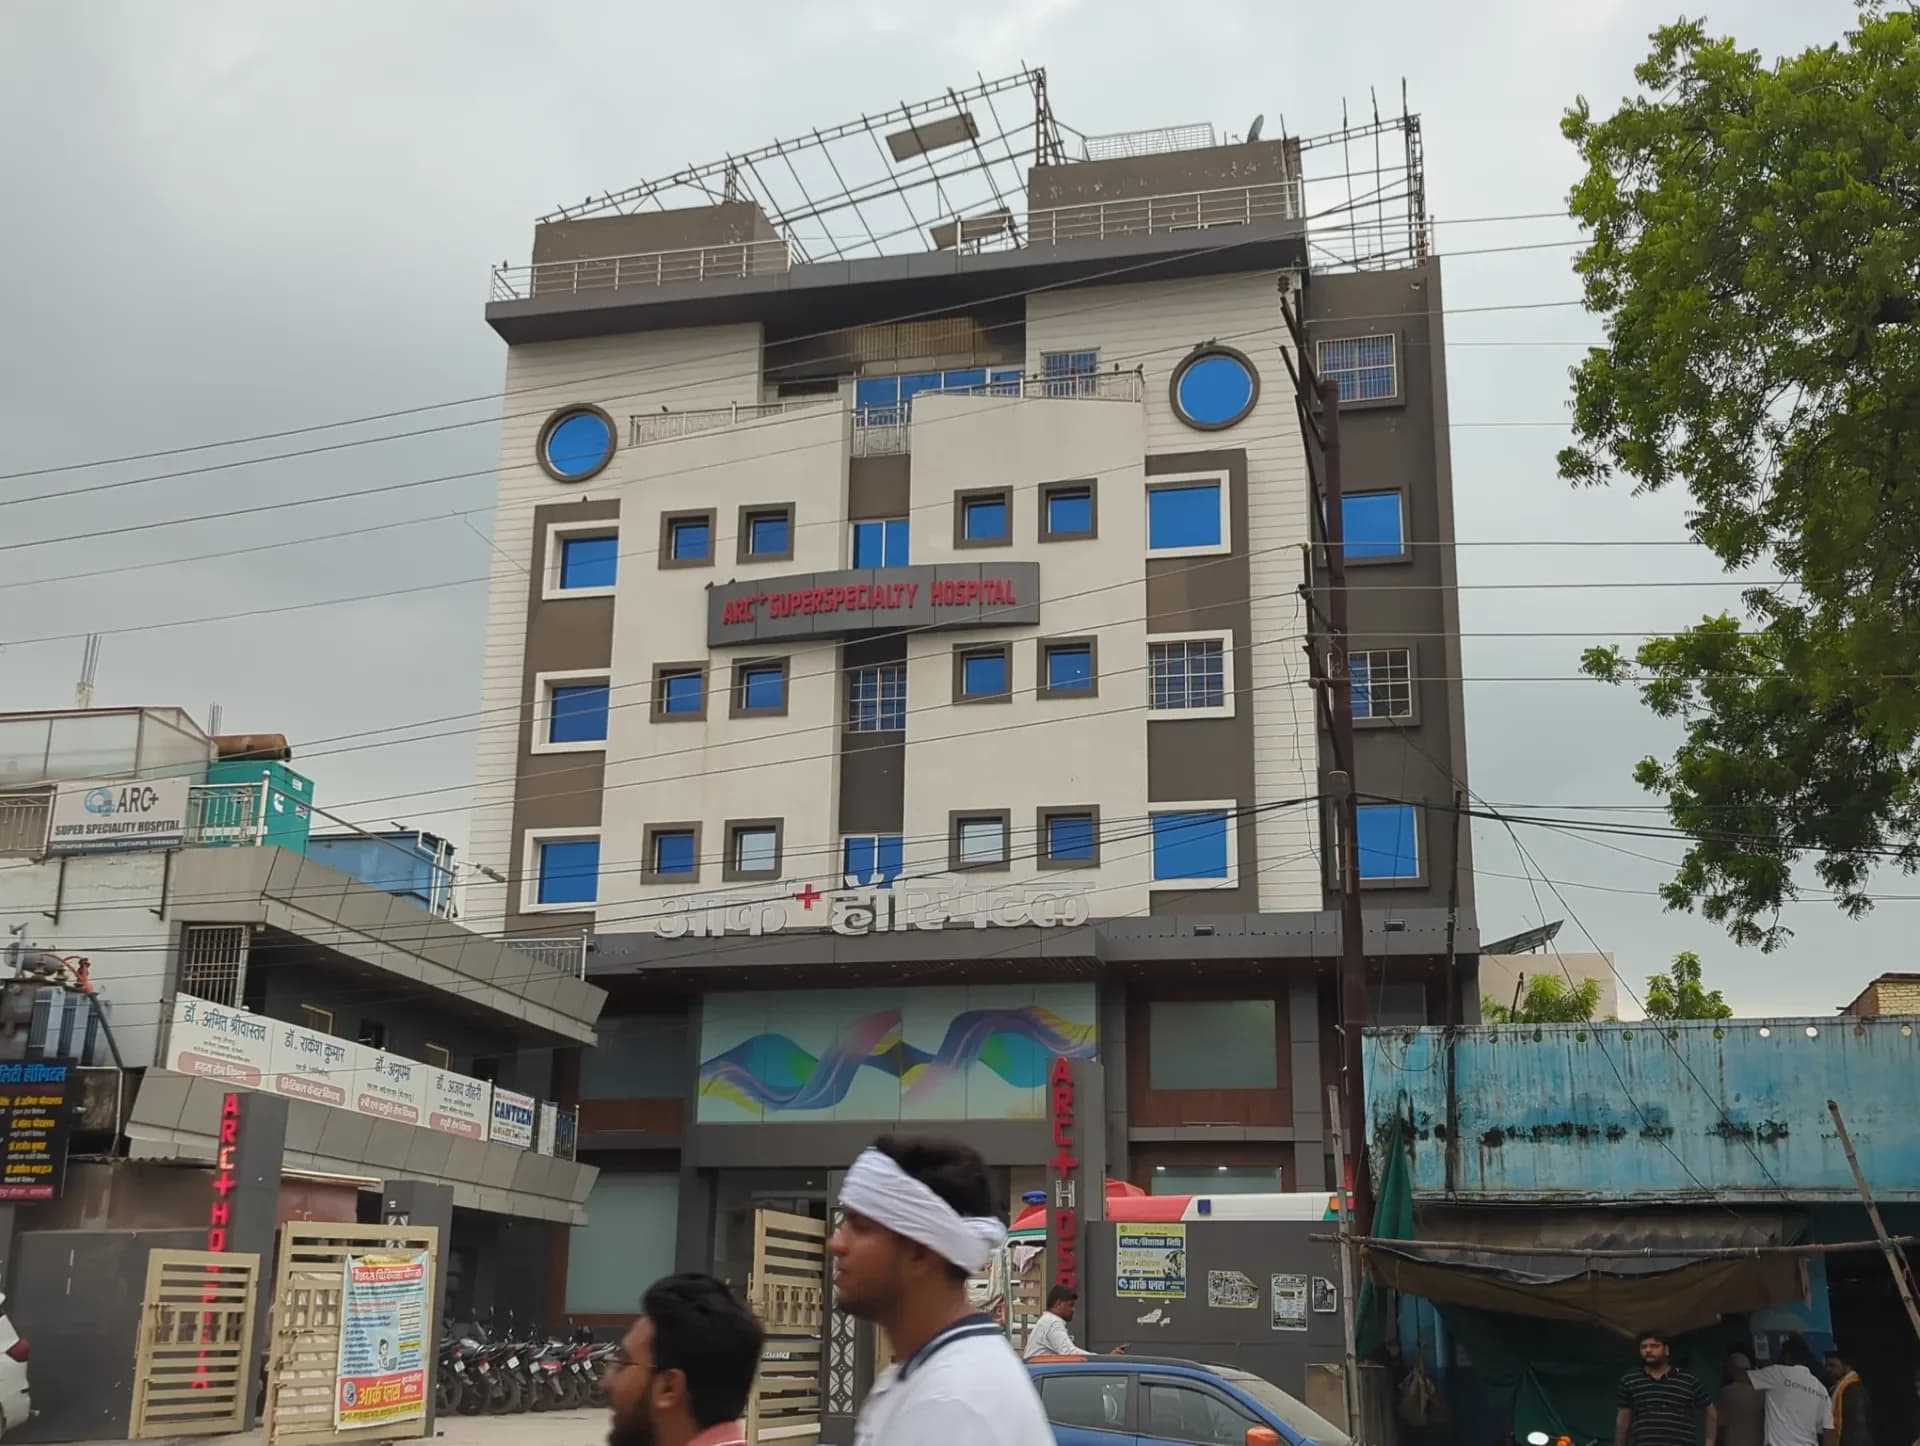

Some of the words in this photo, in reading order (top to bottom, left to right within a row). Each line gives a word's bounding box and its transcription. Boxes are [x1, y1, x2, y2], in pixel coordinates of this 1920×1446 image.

[769, 583, 919, 620] SUPERSPECIALTY
[930, 579, 1017, 607] HOSPITAL
[55, 824, 84, 835] SUPER
[86, 822, 136, 834] SPECIALITY
[137, 820, 180, 832] HOSPITAL
[830, 871, 1097, 937] हॉस्पिटल
[202, 1008, 228, 1032] अमित
[230, 1014, 266, 1042] श्रीवास्तव
[300, 1034, 323, 1056] राकेश
[324, 1043, 346, 1064] कुमार
[494, 1100, 533, 1127] CANTEEN
[358, 1380, 383, 1406] आर्क
[383, 1378, 401, 1403] प्लस
